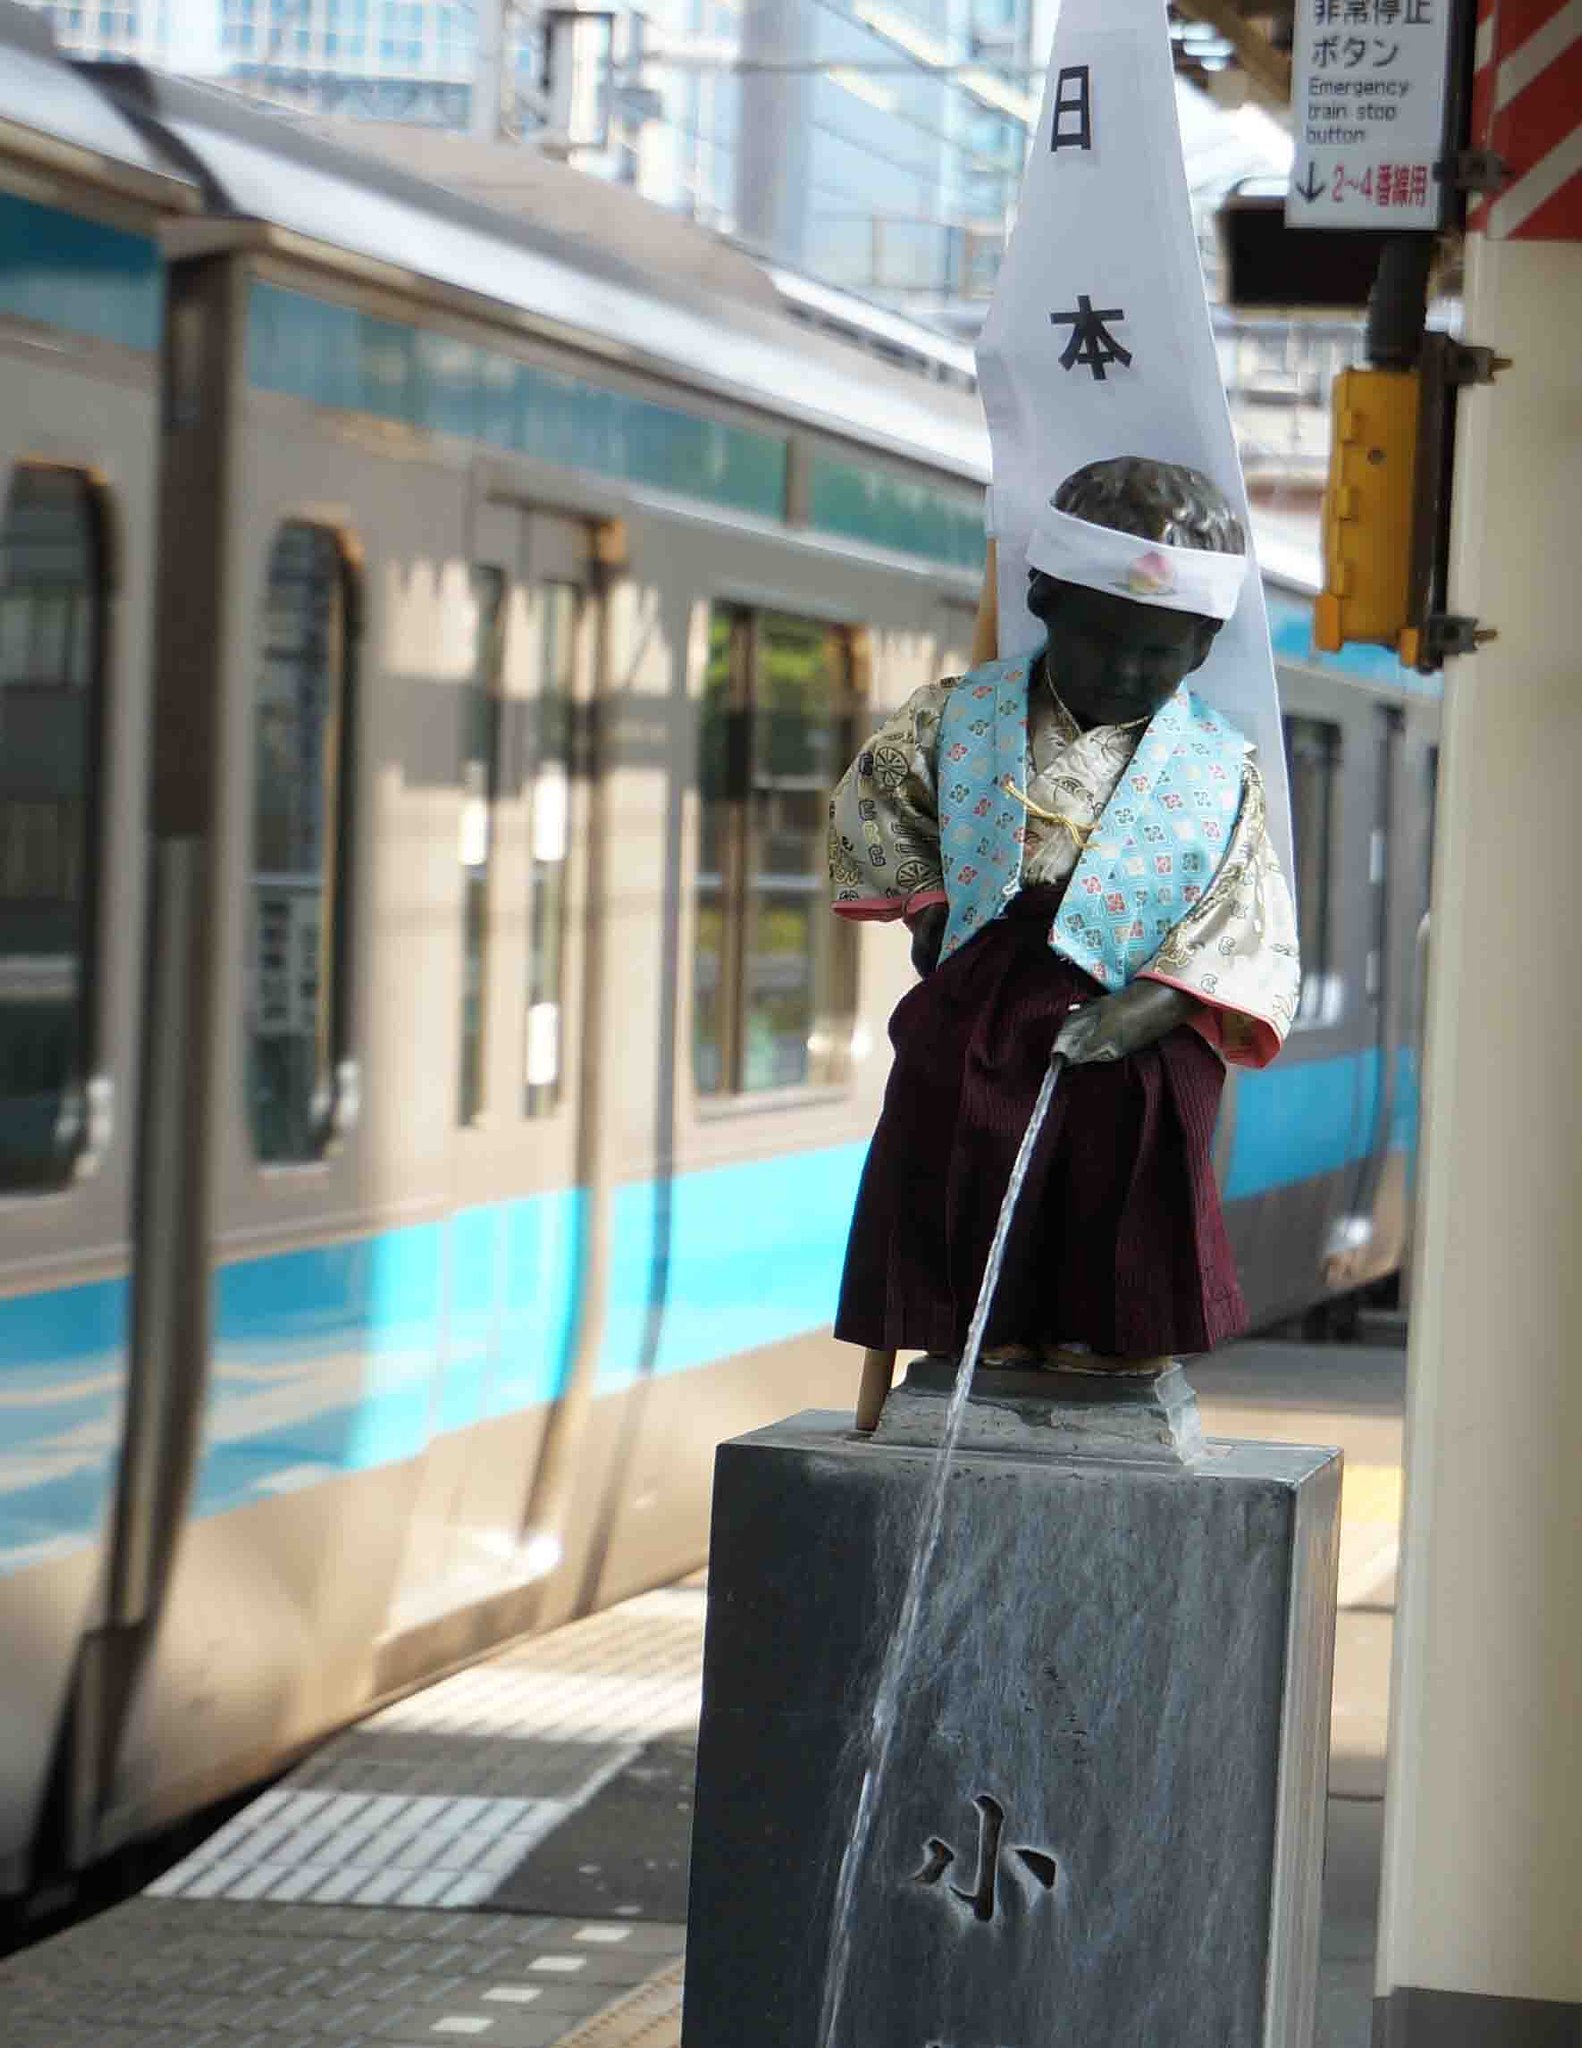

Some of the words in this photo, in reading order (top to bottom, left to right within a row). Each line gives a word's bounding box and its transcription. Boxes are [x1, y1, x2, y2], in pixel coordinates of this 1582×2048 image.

[1313, 0, 1432, 26] 非常停止
[1311, 35, 1399, 68] ボタン
[1307, 77, 1411, 98] Emergency
[1307, 102, 1347, 121] train
[1355, 103, 1398, 122] stop
[1306, 125, 1366, 144] button
